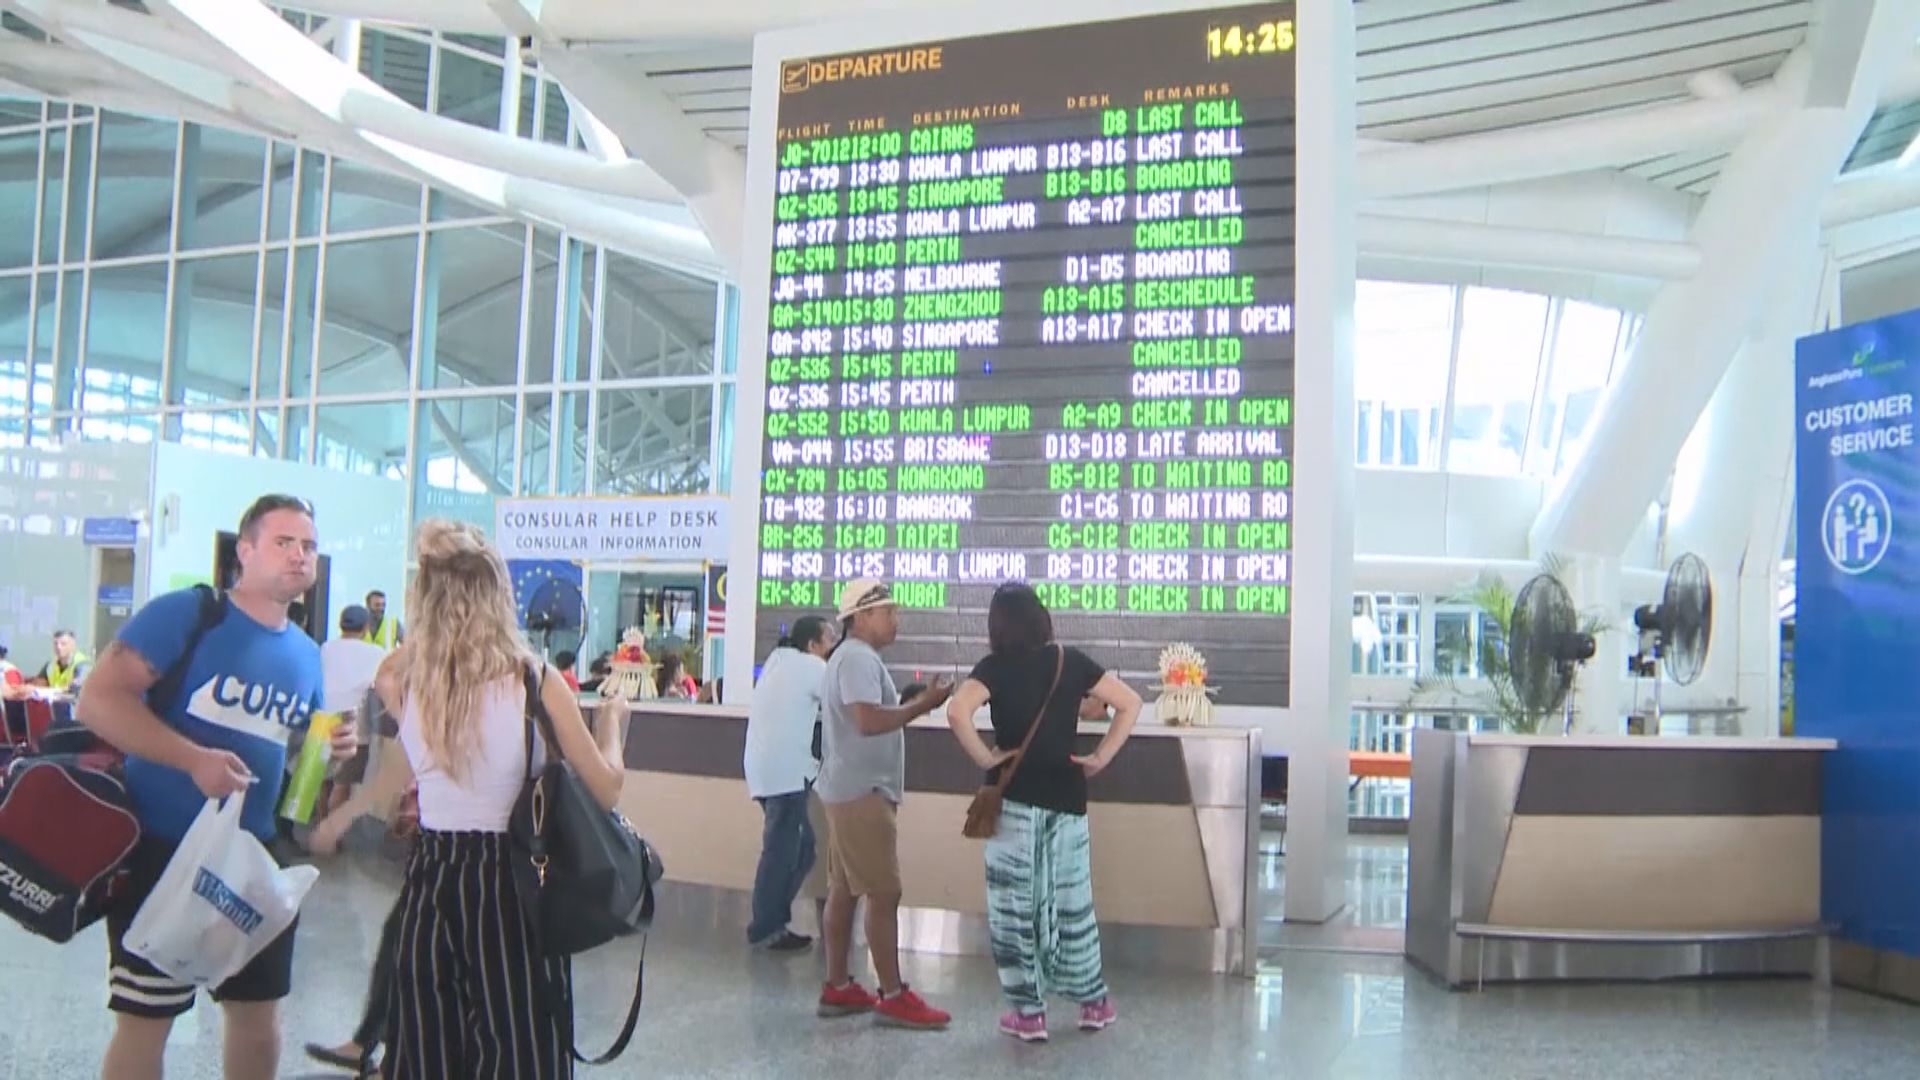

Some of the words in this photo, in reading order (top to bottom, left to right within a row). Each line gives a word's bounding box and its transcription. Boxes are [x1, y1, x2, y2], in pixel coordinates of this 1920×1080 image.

[810, 47, 942, 83] DEPARTURE
[779, 123, 831, 139] FLIGHT
[849, 118, 885, 131] TIME
[913, 103, 1021, 124] DESTINATION
[1068, 95, 1110, 109] DESK
[1144, 83, 1230, 102] REMARKS
[910, 124, 973, 153] CAIRNS
[1104, 110, 1127, 136] D8
[1137, 105, 1182, 132] LAST
[1195, 100, 1242, 125] CALL
[850, 160, 899, 186] 13:30
[909, 153, 961, 181] KUALA
[971, 146, 1037, 175] LUMPUR
[1047, 139, 1126, 169] B13-B16
[1136, 133, 1182, 161] LAST
[1195, 129, 1242, 156] CALL
[849, 187, 898, 213] 13:45
[907, 177, 1003, 208] SINGAPORE
[1047, 169, 1125, 197] B13-B16
[1136, 159, 1230, 190] BOARDING
[848, 214, 897, 241] 13:55
[906, 210, 959, 236] KUALA
[969, 203, 1035, 231] LUMPUR
[1068, 196, 1125, 225] A2-A7
[1136, 192, 1181, 219] LAST
[1194, 188, 1242, 215] CALL
[846, 242, 896, 268] 14:00
[905, 239, 959, 263] PERTH
[1136, 218, 1242, 247] CANCELLED
[845, 270, 895, 296] 14:25
[904, 262, 1001, 290] MELBOURNE
[1067, 255, 1124, 282] D1-D5
[1135, 248, 1230, 277] BOARDING
[903, 291, 1000, 320] ZHENGZHOU
[1043, 284, 1123, 313] A13-A15
[1135, 276, 1254, 307] RESCHEDULE
[843, 326, 893, 351] 15:40
[903, 319, 999, 346] SINGAPORE
[1042, 313, 1123, 342] A13-A17
[1134, 309, 1194, 337] CHECK
[1206, 308, 1229, 334] IN
[1241, 306, 1290, 333] OPEN
[842, 352, 892, 378] 15:45
[901, 351, 955, 376] PERTH
[1133, 339, 1241, 366] CANCELLED
[841, 381, 891, 405] 15:45
[900, 380, 954, 405] PERTH
[1132, 369, 1240, 396] CANCELLED
[840, 409, 890, 435] 15:50
[900, 408, 953, 433] KUALA
[963, 405, 1030, 432] LUMPUR
[1063, 403, 1121, 428] A2-A9
[1132, 401, 1192, 427] CHECK
[1204, 400, 1228, 425] IN
[1239, 399, 1288, 425] OPEN
[1805, 394, 1913, 431] CUSTOMER
[844, 439, 894, 463] 15:55
[904, 436, 990, 462] BRISBANE
[1046, 433, 1127, 459] D13-D18
[1138, 432, 1185, 456] LATE
[1197, 431, 1282, 455] ARRIVAL
[1830, 424, 1913, 456] SERVICE
[765, 468, 825, 492] CX-784
[837, 467, 887, 490] 16:05
[897, 466, 984, 490] HONGKONG
[1050, 463, 1119, 489] B5-B12
[1131, 463, 1154, 488] TO
[1166, 461, 1250, 488] WAITING
[1263, 461, 1288, 487] RO
[504, 512, 597, 528] CONSULAR
[611, 511, 656, 527] HELP
[670, 511, 718, 526] DESK
[836, 497, 886, 520] 16:10
[896, 496, 972, 520] BANGKOK
[1060, 494, 1118, 518] C1-C6
[1131, 494, 1154, 518] TO
[1166, 493, 1250, 518] WAITING
[1262, 492, 1287, 518] RO
[515, 536, 588, 549] CONSULAR
[600, 536, 701, 549] INFORMATION
[763, 524, 823, 548] BR-256
[835, 524, 886, 548] 16:20
[896, 524, 958, 548] TAIPEI
[1048, 524, 1118, 548] C6-C12
[1129, 524, 1189, 548] CHECK
[1203, 524, 1226, 548] IN
[1237, 523, 1287, 549] OPEN
[834, 553, 885, 577] 16:25
[894, 553, 948, 577] KUALA
[959, 554, 1025, 578] LUMPUR
[1048, 555, 1117, 579] D8-D12
[1128, 555, 1189, 580] CHECK
[1202, 556, 1224, 580] IN
[1236, 555, 1287, 580] OPEN
[761, 581, 820, 606] EK-361
[893, 582, 945, 607] DUBAI
[1128, 585, 1188, 610] CHECK
[1201, 585, 1224, 611] IN
[1236, 585, 1286, 613] OPEN
